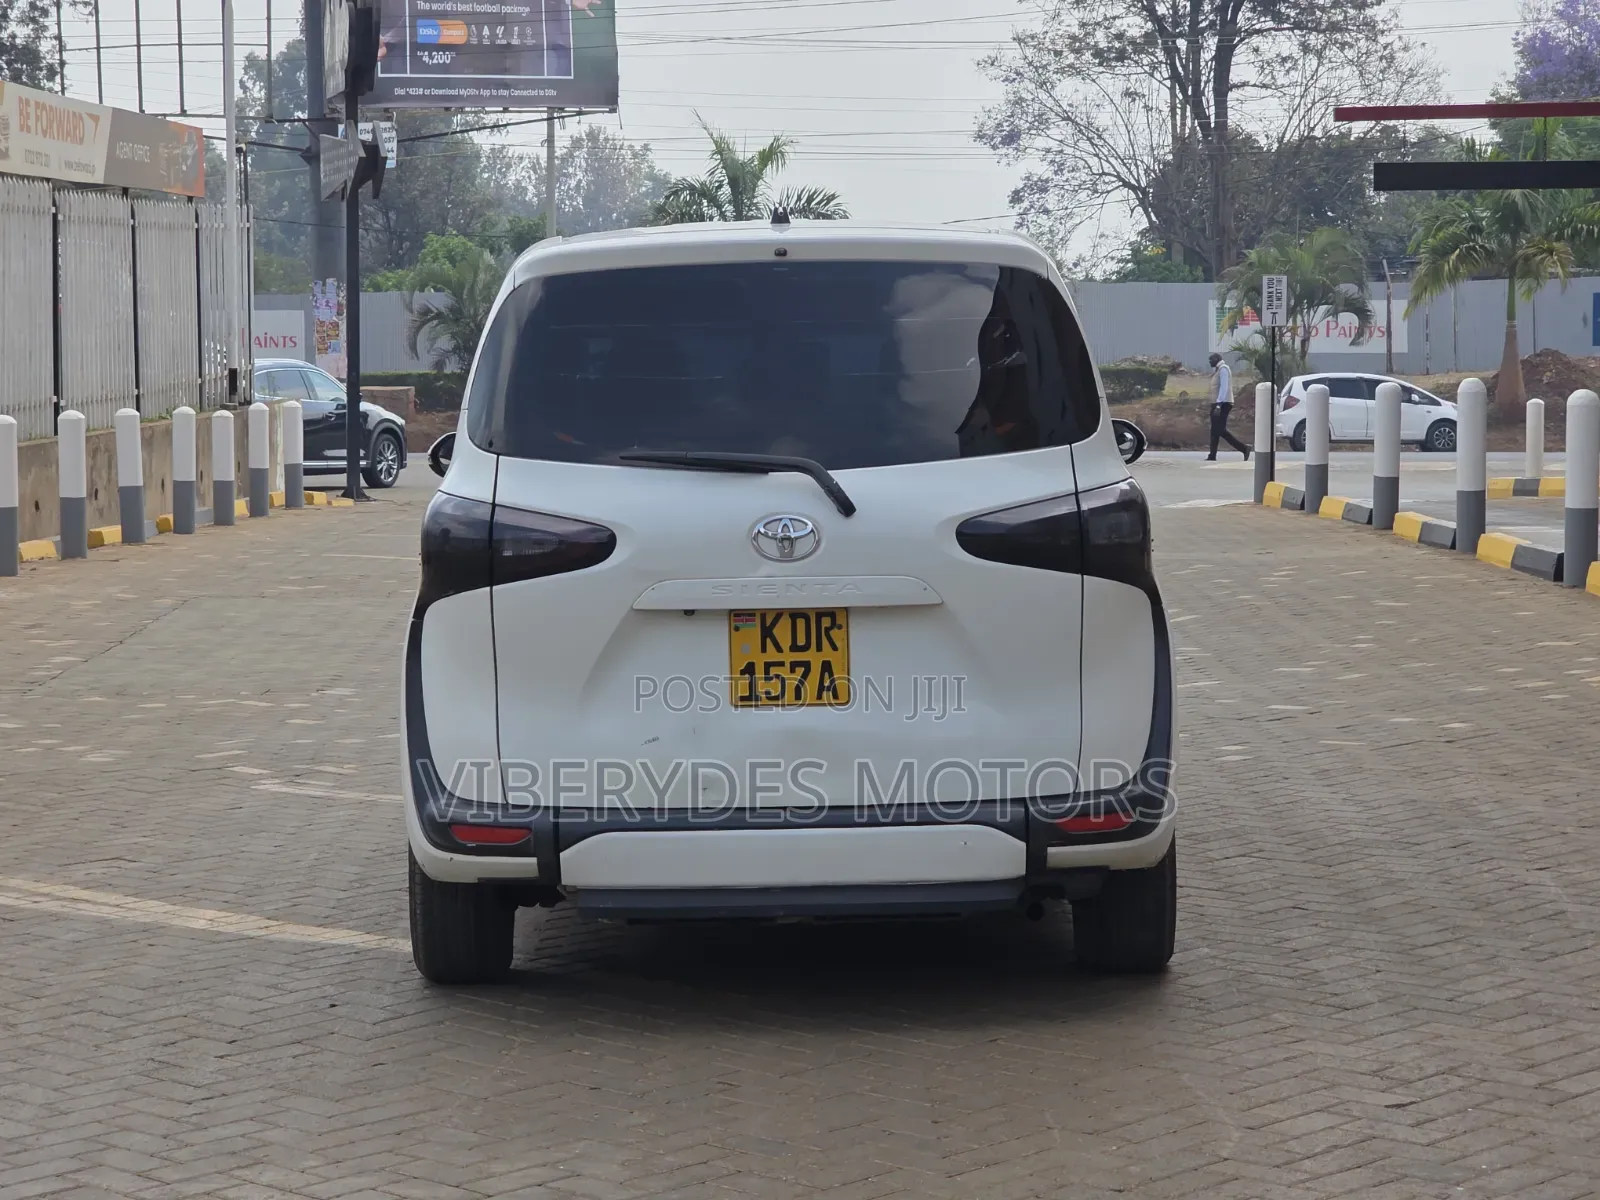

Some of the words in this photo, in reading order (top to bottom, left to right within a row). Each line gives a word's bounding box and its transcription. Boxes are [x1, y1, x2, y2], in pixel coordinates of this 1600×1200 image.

[417, 1, 430, 10] The
[431, 2, 457, 11] world's
[458, 2, 473, 12] best
[474, 3, 500, 13] football
[501, 4, 531, 16] package
[422, 51, 451, 65] 4,200
[394, 87, 406, 95] Dial
[480, 88, 491, 97] App
[491, 88, 497, 96] to
[498, 88, 509, 98] stay
[510, 88, 538, 96] Connected
[18, 95, 31, 134] BE
[34, 100, 85, 146] FORWARD
[1266, 277, 1275, 289] YOU
[1266, 290, 1274, 310] THANK
[1275, 288, 1283, 302] NEXT
[711, 582, 863, 597] SIENTA
[760, 611, 839, 653] KDR
[739, 660, 840, 702] 157A
